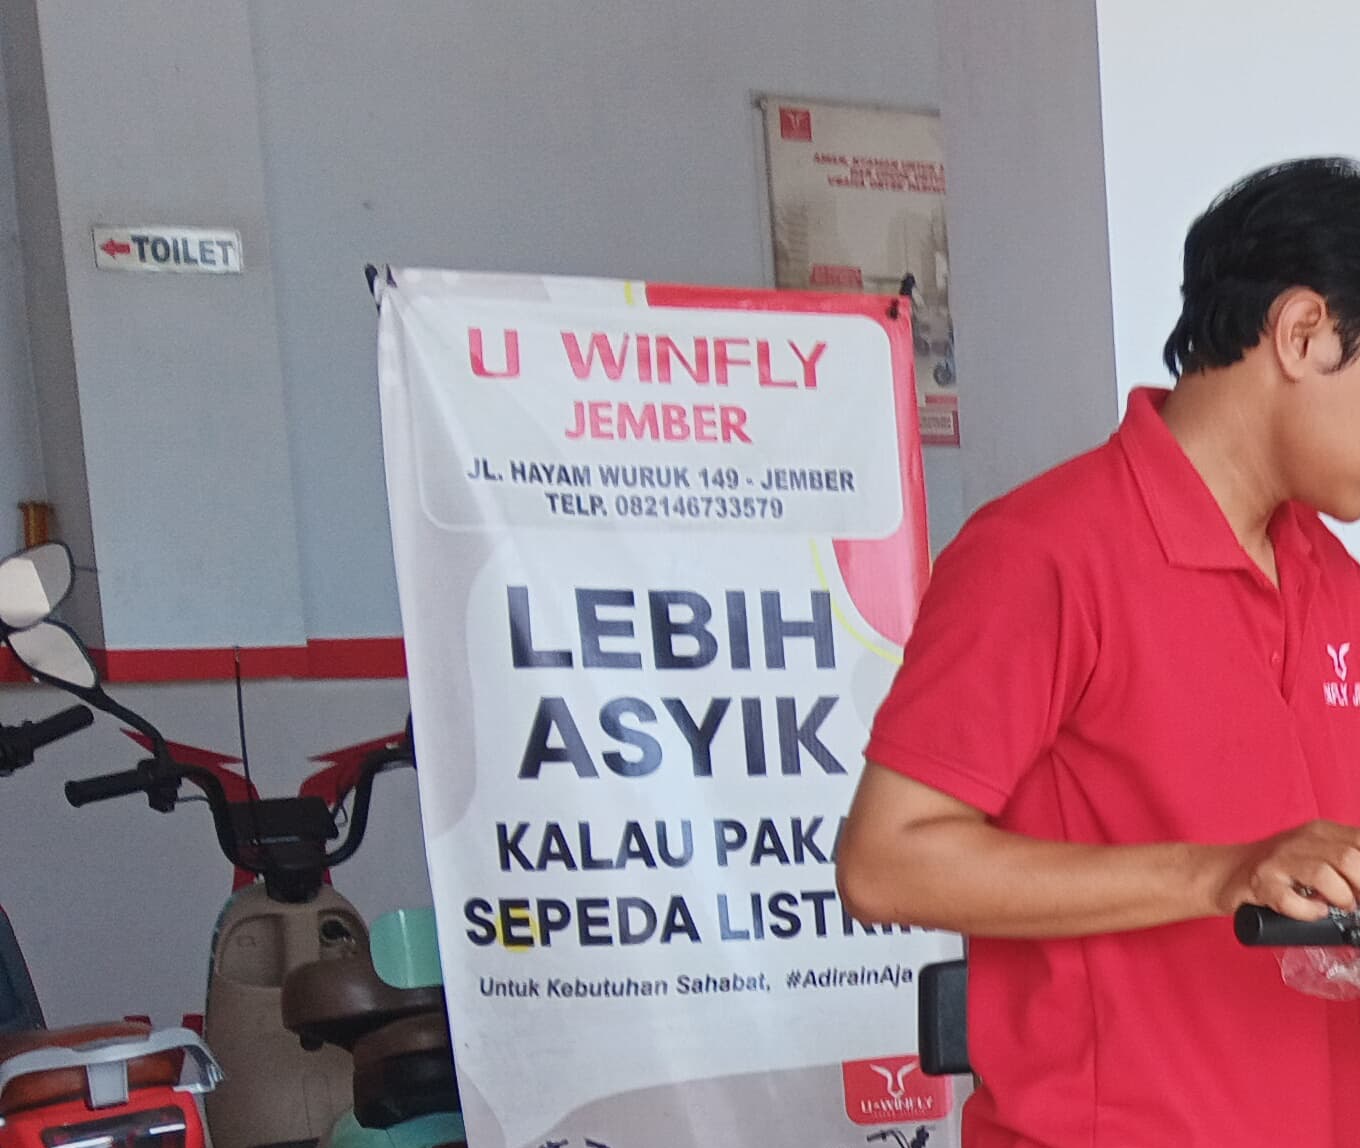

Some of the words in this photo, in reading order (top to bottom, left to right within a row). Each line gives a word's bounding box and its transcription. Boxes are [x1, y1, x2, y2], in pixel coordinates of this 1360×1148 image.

[131, 234, 233, 265] TOILET
[467, 326, 520, 378] U
[560, 330, 829, 389] WINFLY
[564, 400, 754, 444] JEMBER
[467, 458, 504, 483] JL.
[510, 459, 592, 488] HAYAM
[598, 465, 691, 489] WURUK
[699, 467, 739, 490] 149
[760, 468, 856, 493] JEMBER
[544, 492, 608, 517] TELP.
[615, 494, 784, 520] 082146733579
[505, 584, 838, 672] LEBIH
[517, 696, 848, 780] ASYIK
[495, 817, 695, 872] KALAU
[463, 895, 701, 948] SEPEDA
[480, 976, 540, 998] Untuk
[546, 976, 669, 998] Kebutuhan
[676, 972, 771, 996] Sahabat,
[785, 964, 913, 989] #AdirainAja
